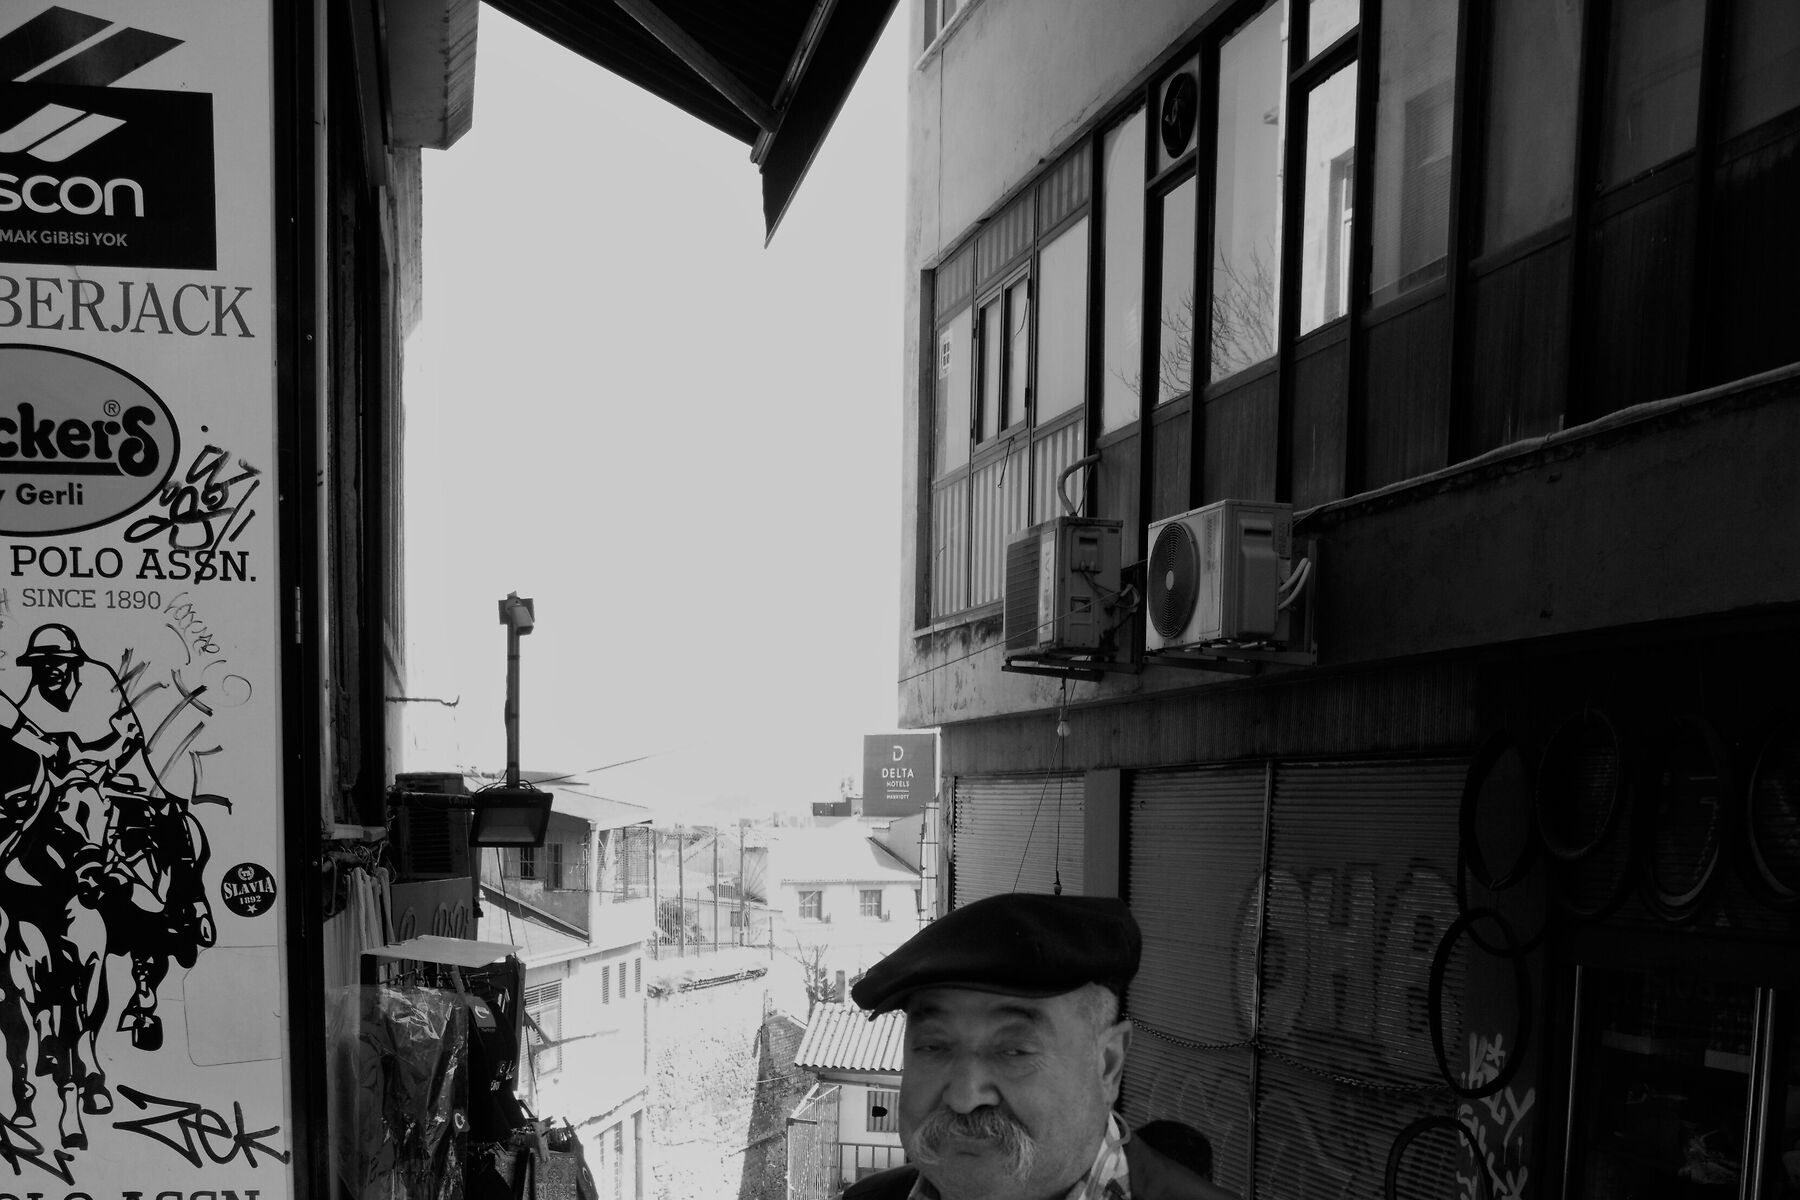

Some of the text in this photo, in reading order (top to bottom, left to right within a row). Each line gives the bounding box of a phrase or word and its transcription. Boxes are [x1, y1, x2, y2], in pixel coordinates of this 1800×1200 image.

[92, 232, 128, 247] YOK
[0, 275, 255, 338] BERJACK
[16, 482, 83, 506] Gerli
[10, 545, 257, 583] POLO ASSN.
[22, 588, 161, 610] SINCE 1890
[881, 768, 914, 778] DELTA
[223, 876, 275, 900] SLAVIA
[240, 895, 262, 904] 1892
